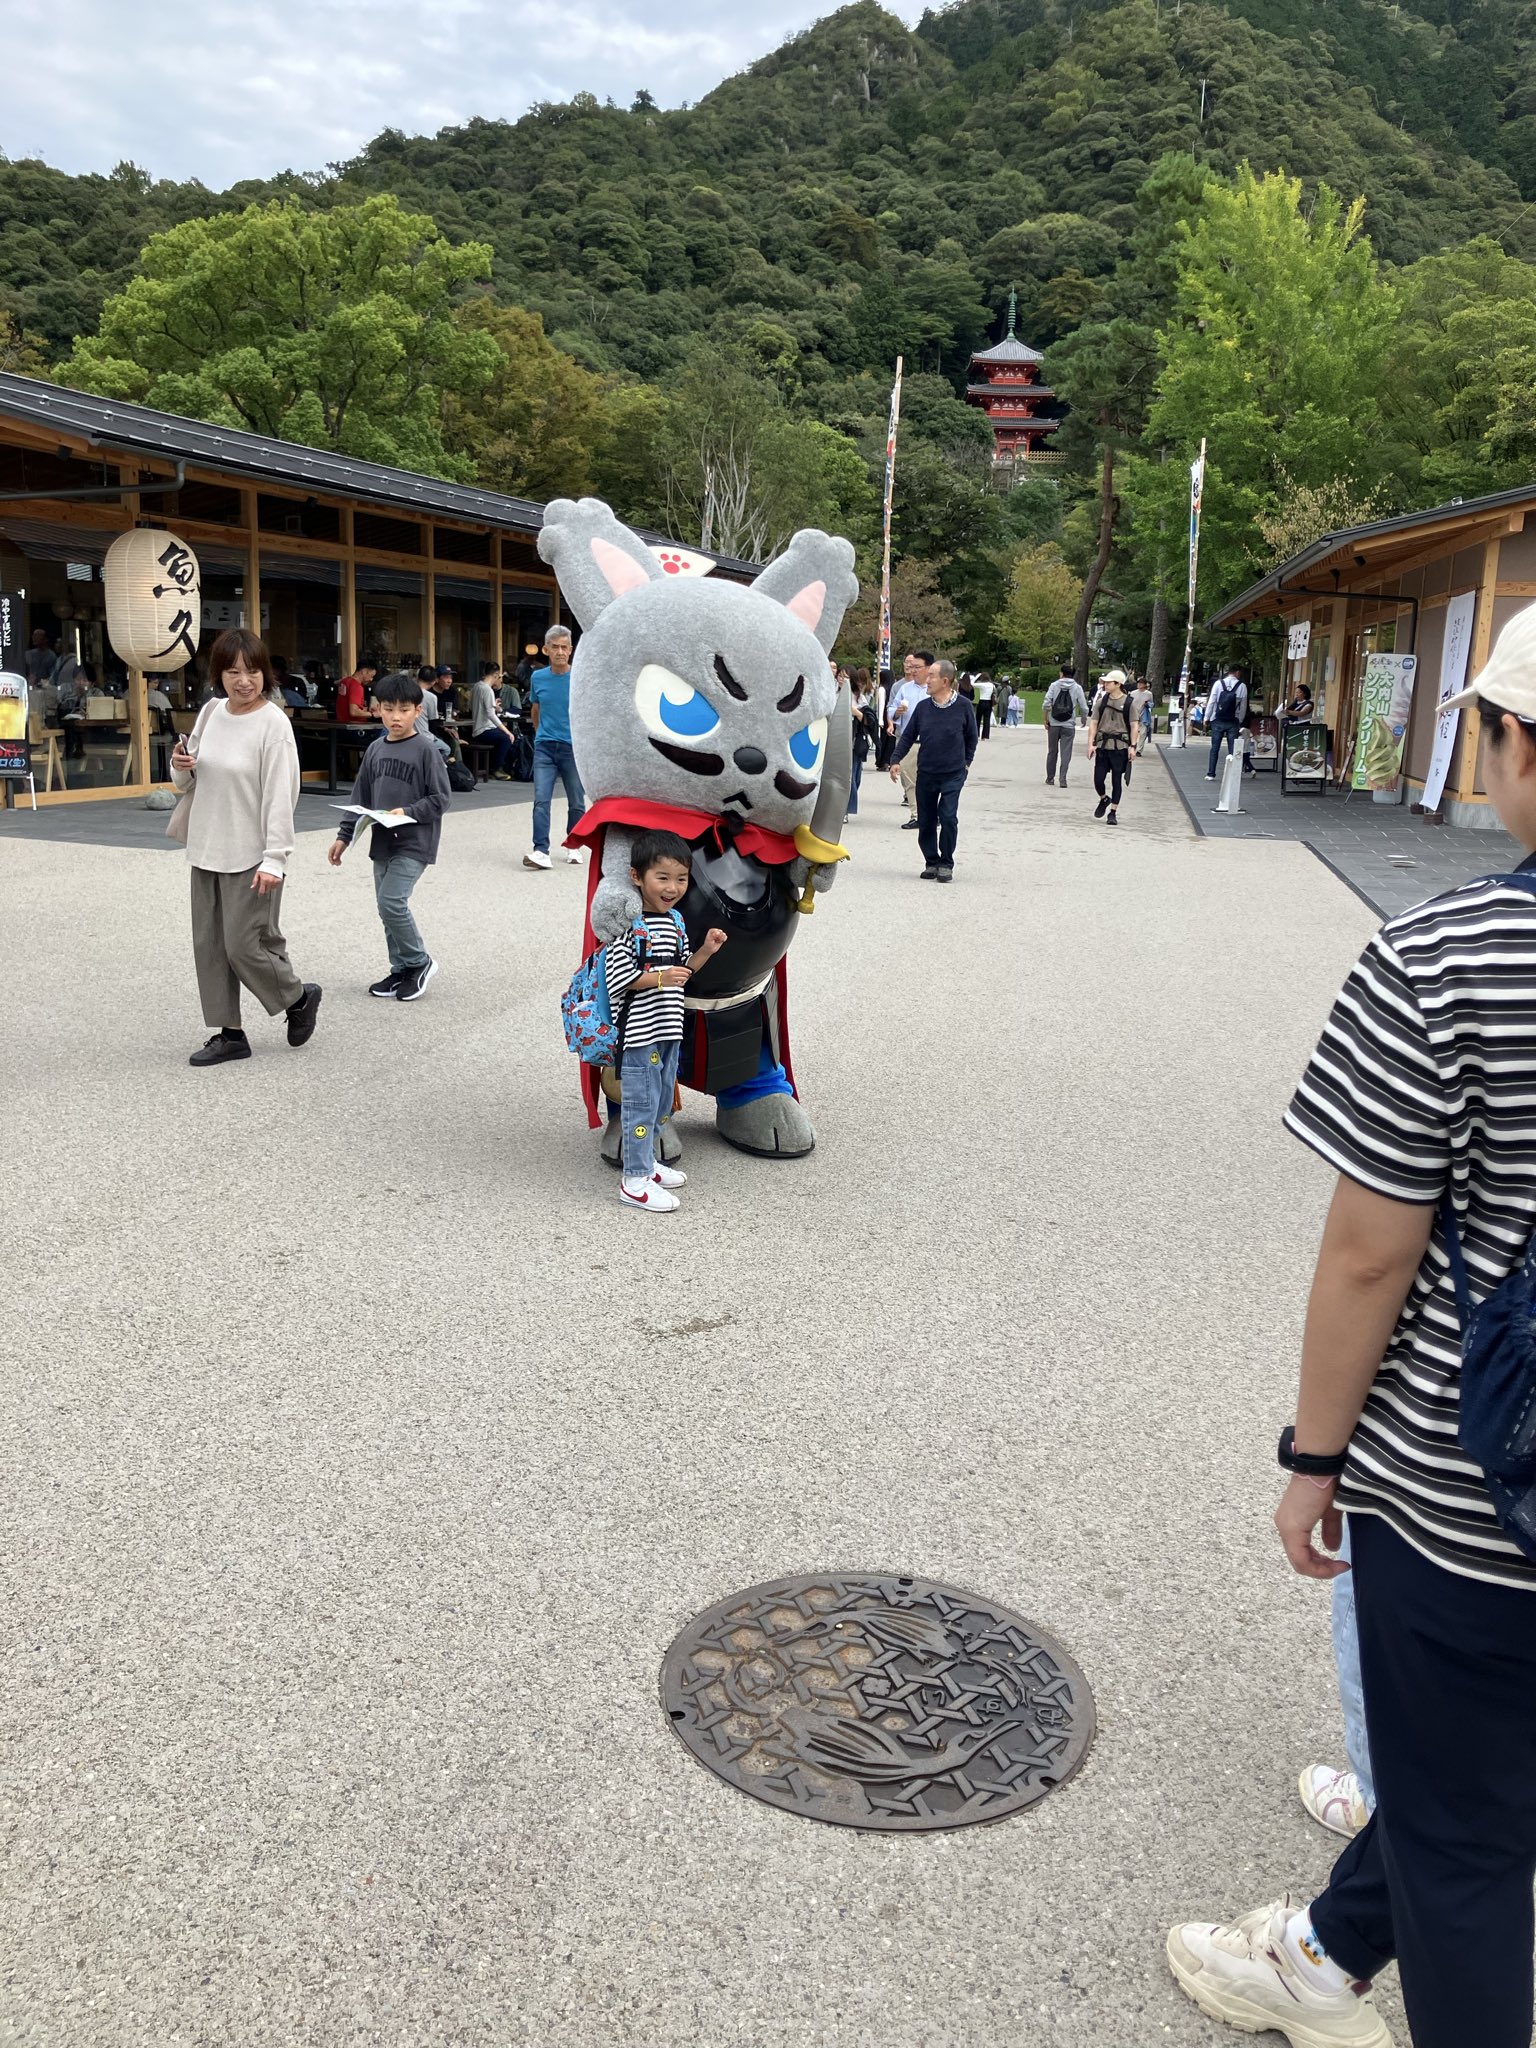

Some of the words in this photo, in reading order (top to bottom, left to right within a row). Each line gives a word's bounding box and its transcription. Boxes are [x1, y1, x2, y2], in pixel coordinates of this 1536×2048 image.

[2, 598, 12, 647] 冷やすほどに
[149, 541, 196, 659] 魚久
[1355, 672, 1381, 773] ソフトクリーム
[1376, 671, 1394, 716] 大内山
